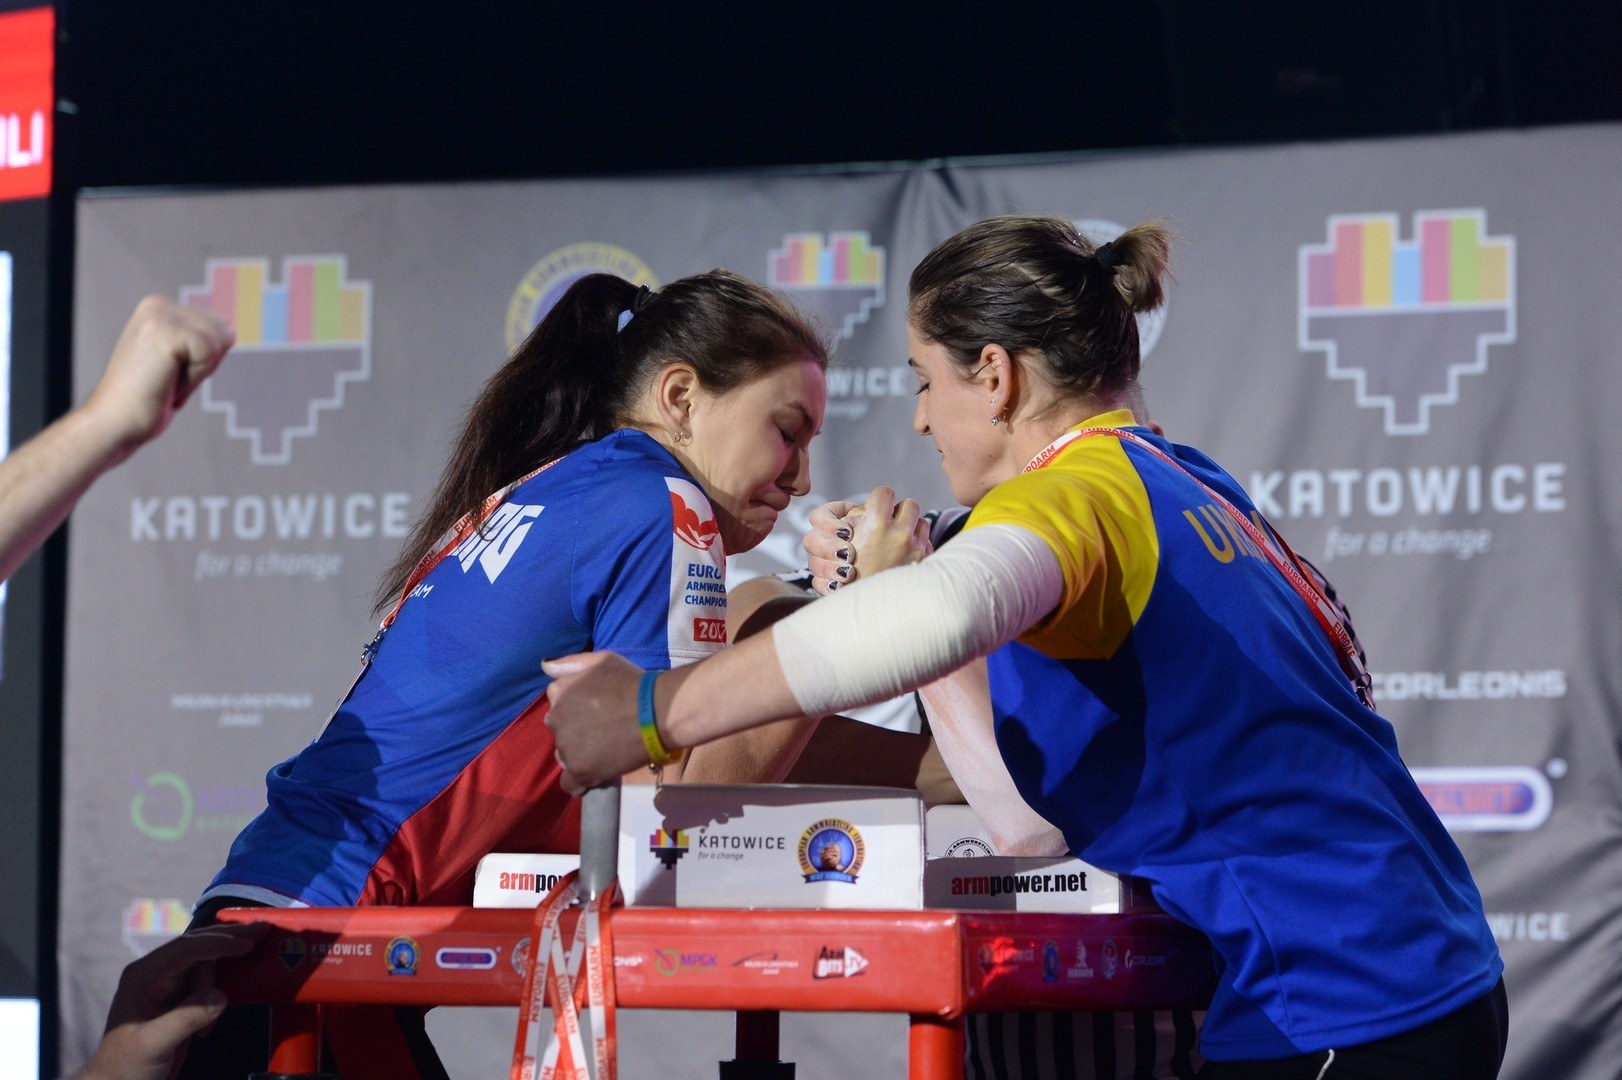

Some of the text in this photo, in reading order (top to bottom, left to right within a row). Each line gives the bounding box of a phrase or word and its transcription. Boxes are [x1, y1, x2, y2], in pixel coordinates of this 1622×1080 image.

[828, 367, 911, 397] WICE
[1022, 444, 1056, 474] ROARM
[1249, 463, 1568, 520] KATOWICE
[130, 491, 412, 541] KATOWICE
[1282, 560, 1320, 604] EUROARM
[699, 836, 785, 850] KATOWICE
[500, 872, 564, 893] armpo
[951, 872, 1088, 897] armpower.net
[1486, 912, 1569, 942] WICE
